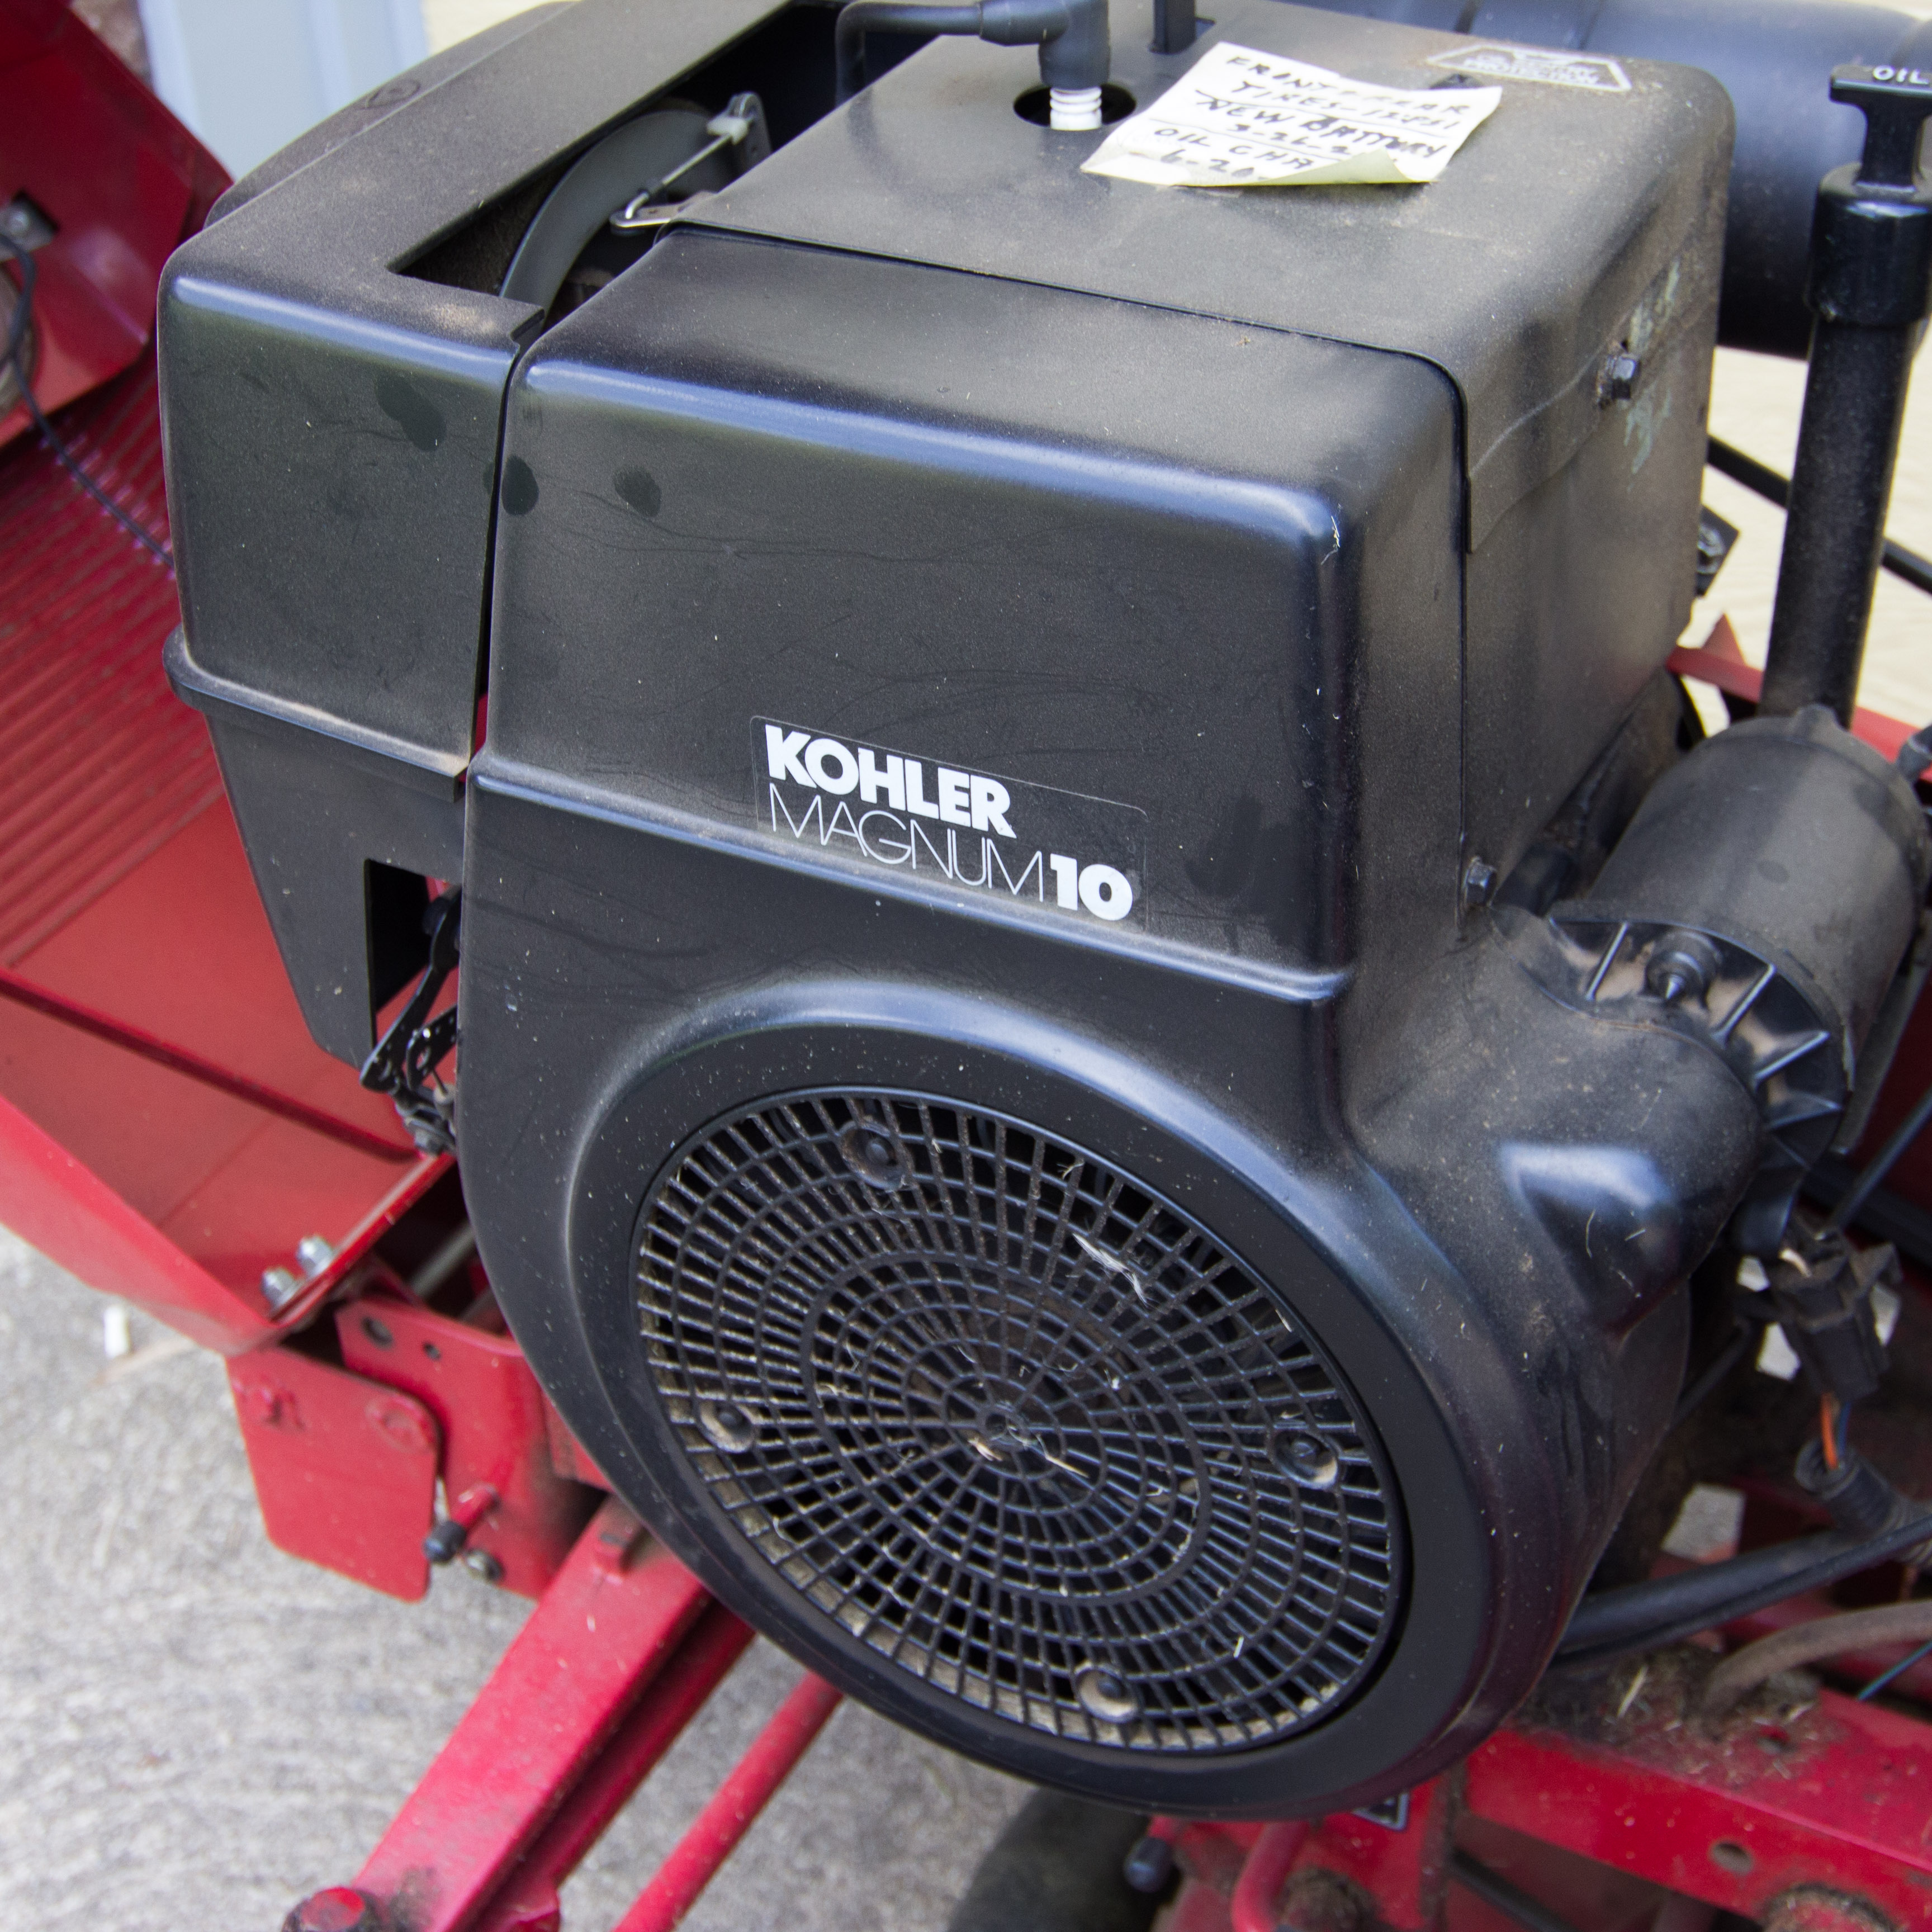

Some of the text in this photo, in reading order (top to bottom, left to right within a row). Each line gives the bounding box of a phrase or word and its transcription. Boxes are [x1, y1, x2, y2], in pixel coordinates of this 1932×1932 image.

[1873, 65, 1929, 84] OIL
[1196, 98, 1296, 124] NEW
[1154, 128, 1211, 147] OIL
[765, 724, 1017, 839] KOHLER
[770, 783, 1133, 921] MAGNUM 10
